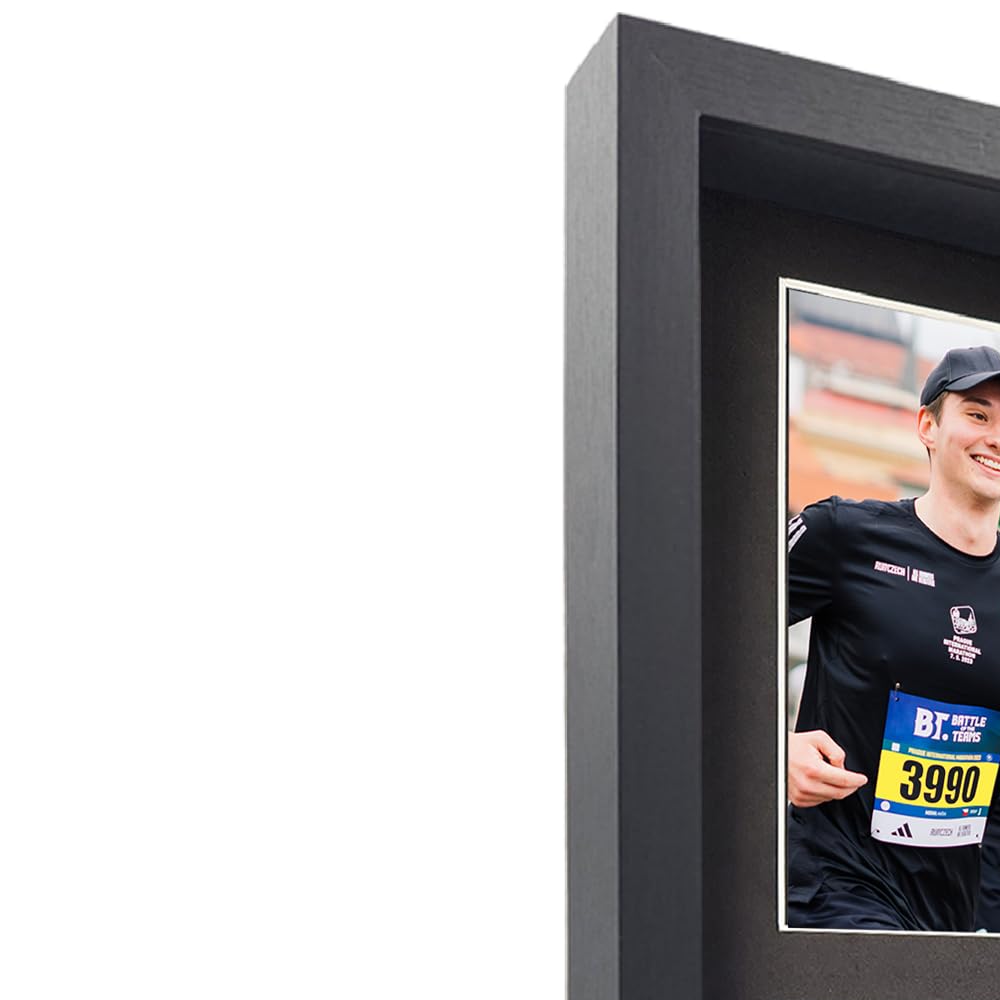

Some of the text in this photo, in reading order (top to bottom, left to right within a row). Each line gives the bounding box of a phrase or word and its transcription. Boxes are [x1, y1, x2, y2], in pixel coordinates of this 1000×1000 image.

[951, 714, 987, 728] BATTLE
[952, 730, 982, 742] TEAMS
[900, 760, 981, 805] 3990
